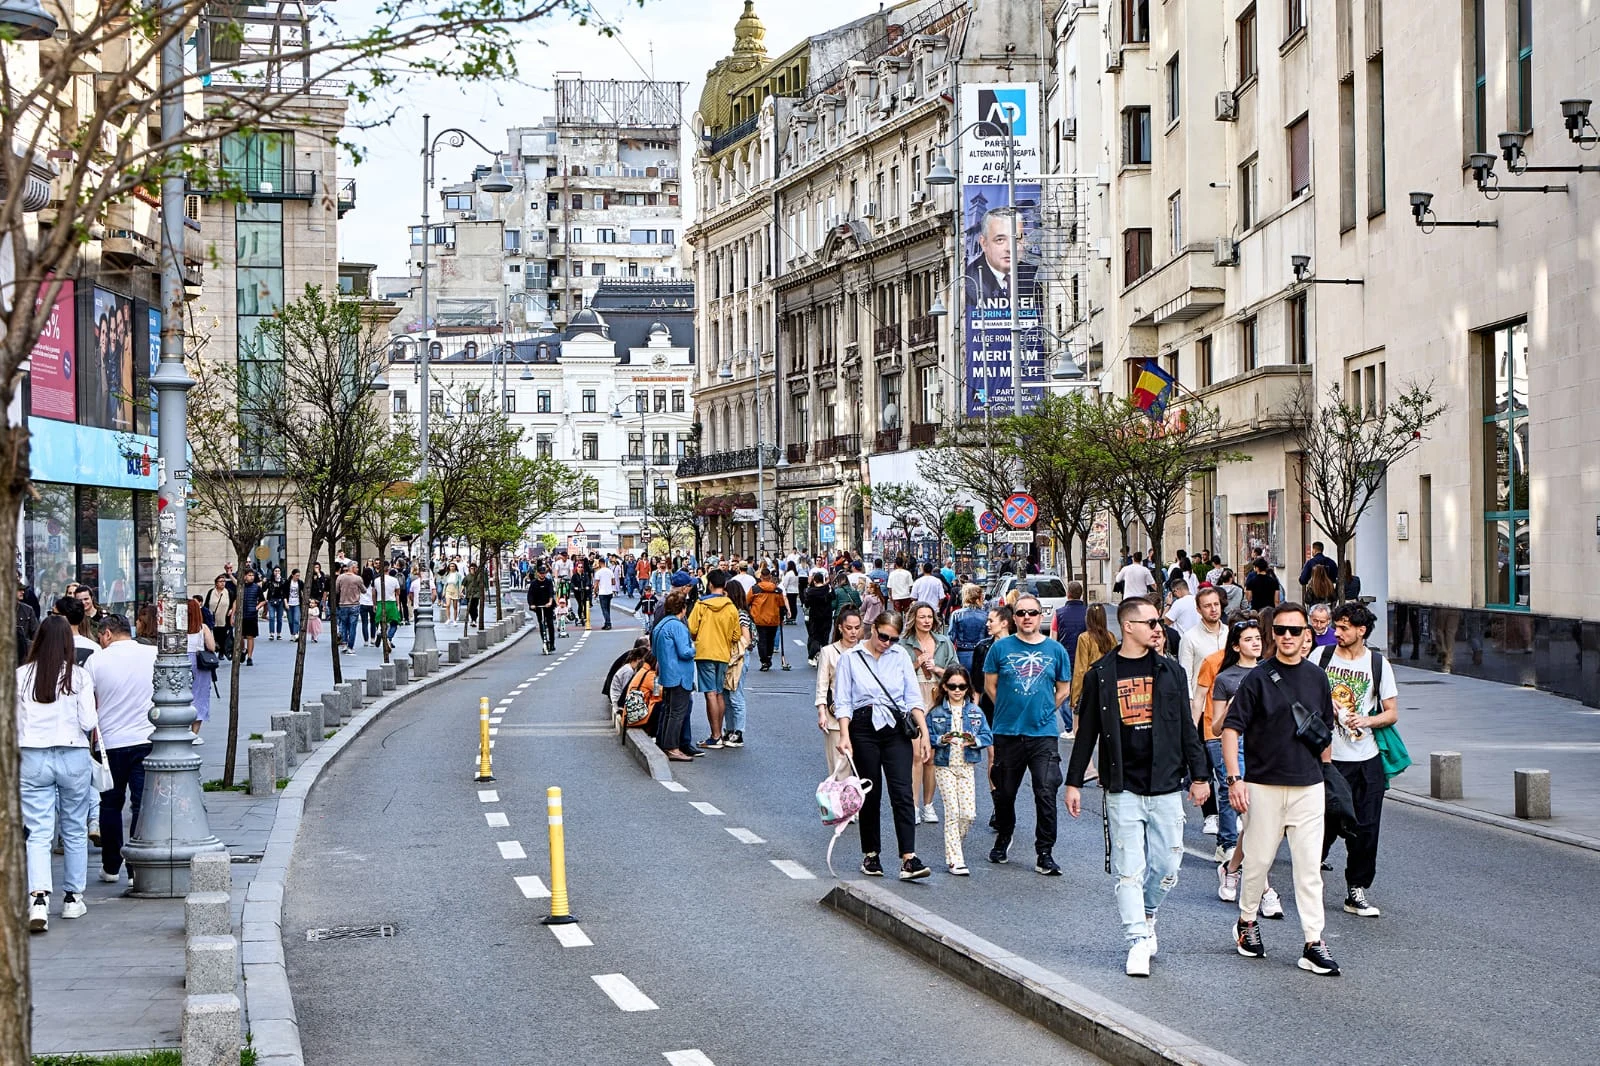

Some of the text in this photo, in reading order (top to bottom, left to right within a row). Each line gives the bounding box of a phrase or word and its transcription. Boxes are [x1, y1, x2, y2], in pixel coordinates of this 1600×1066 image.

[1011, 147, 1036, 157] REAPTĂ
[983, 162, 993, 171] AI
[968, 175, 979, 184] DE
[972, 366, 1038, 378] MAI MLT!
[1130, 693, 1150, 704] AND
